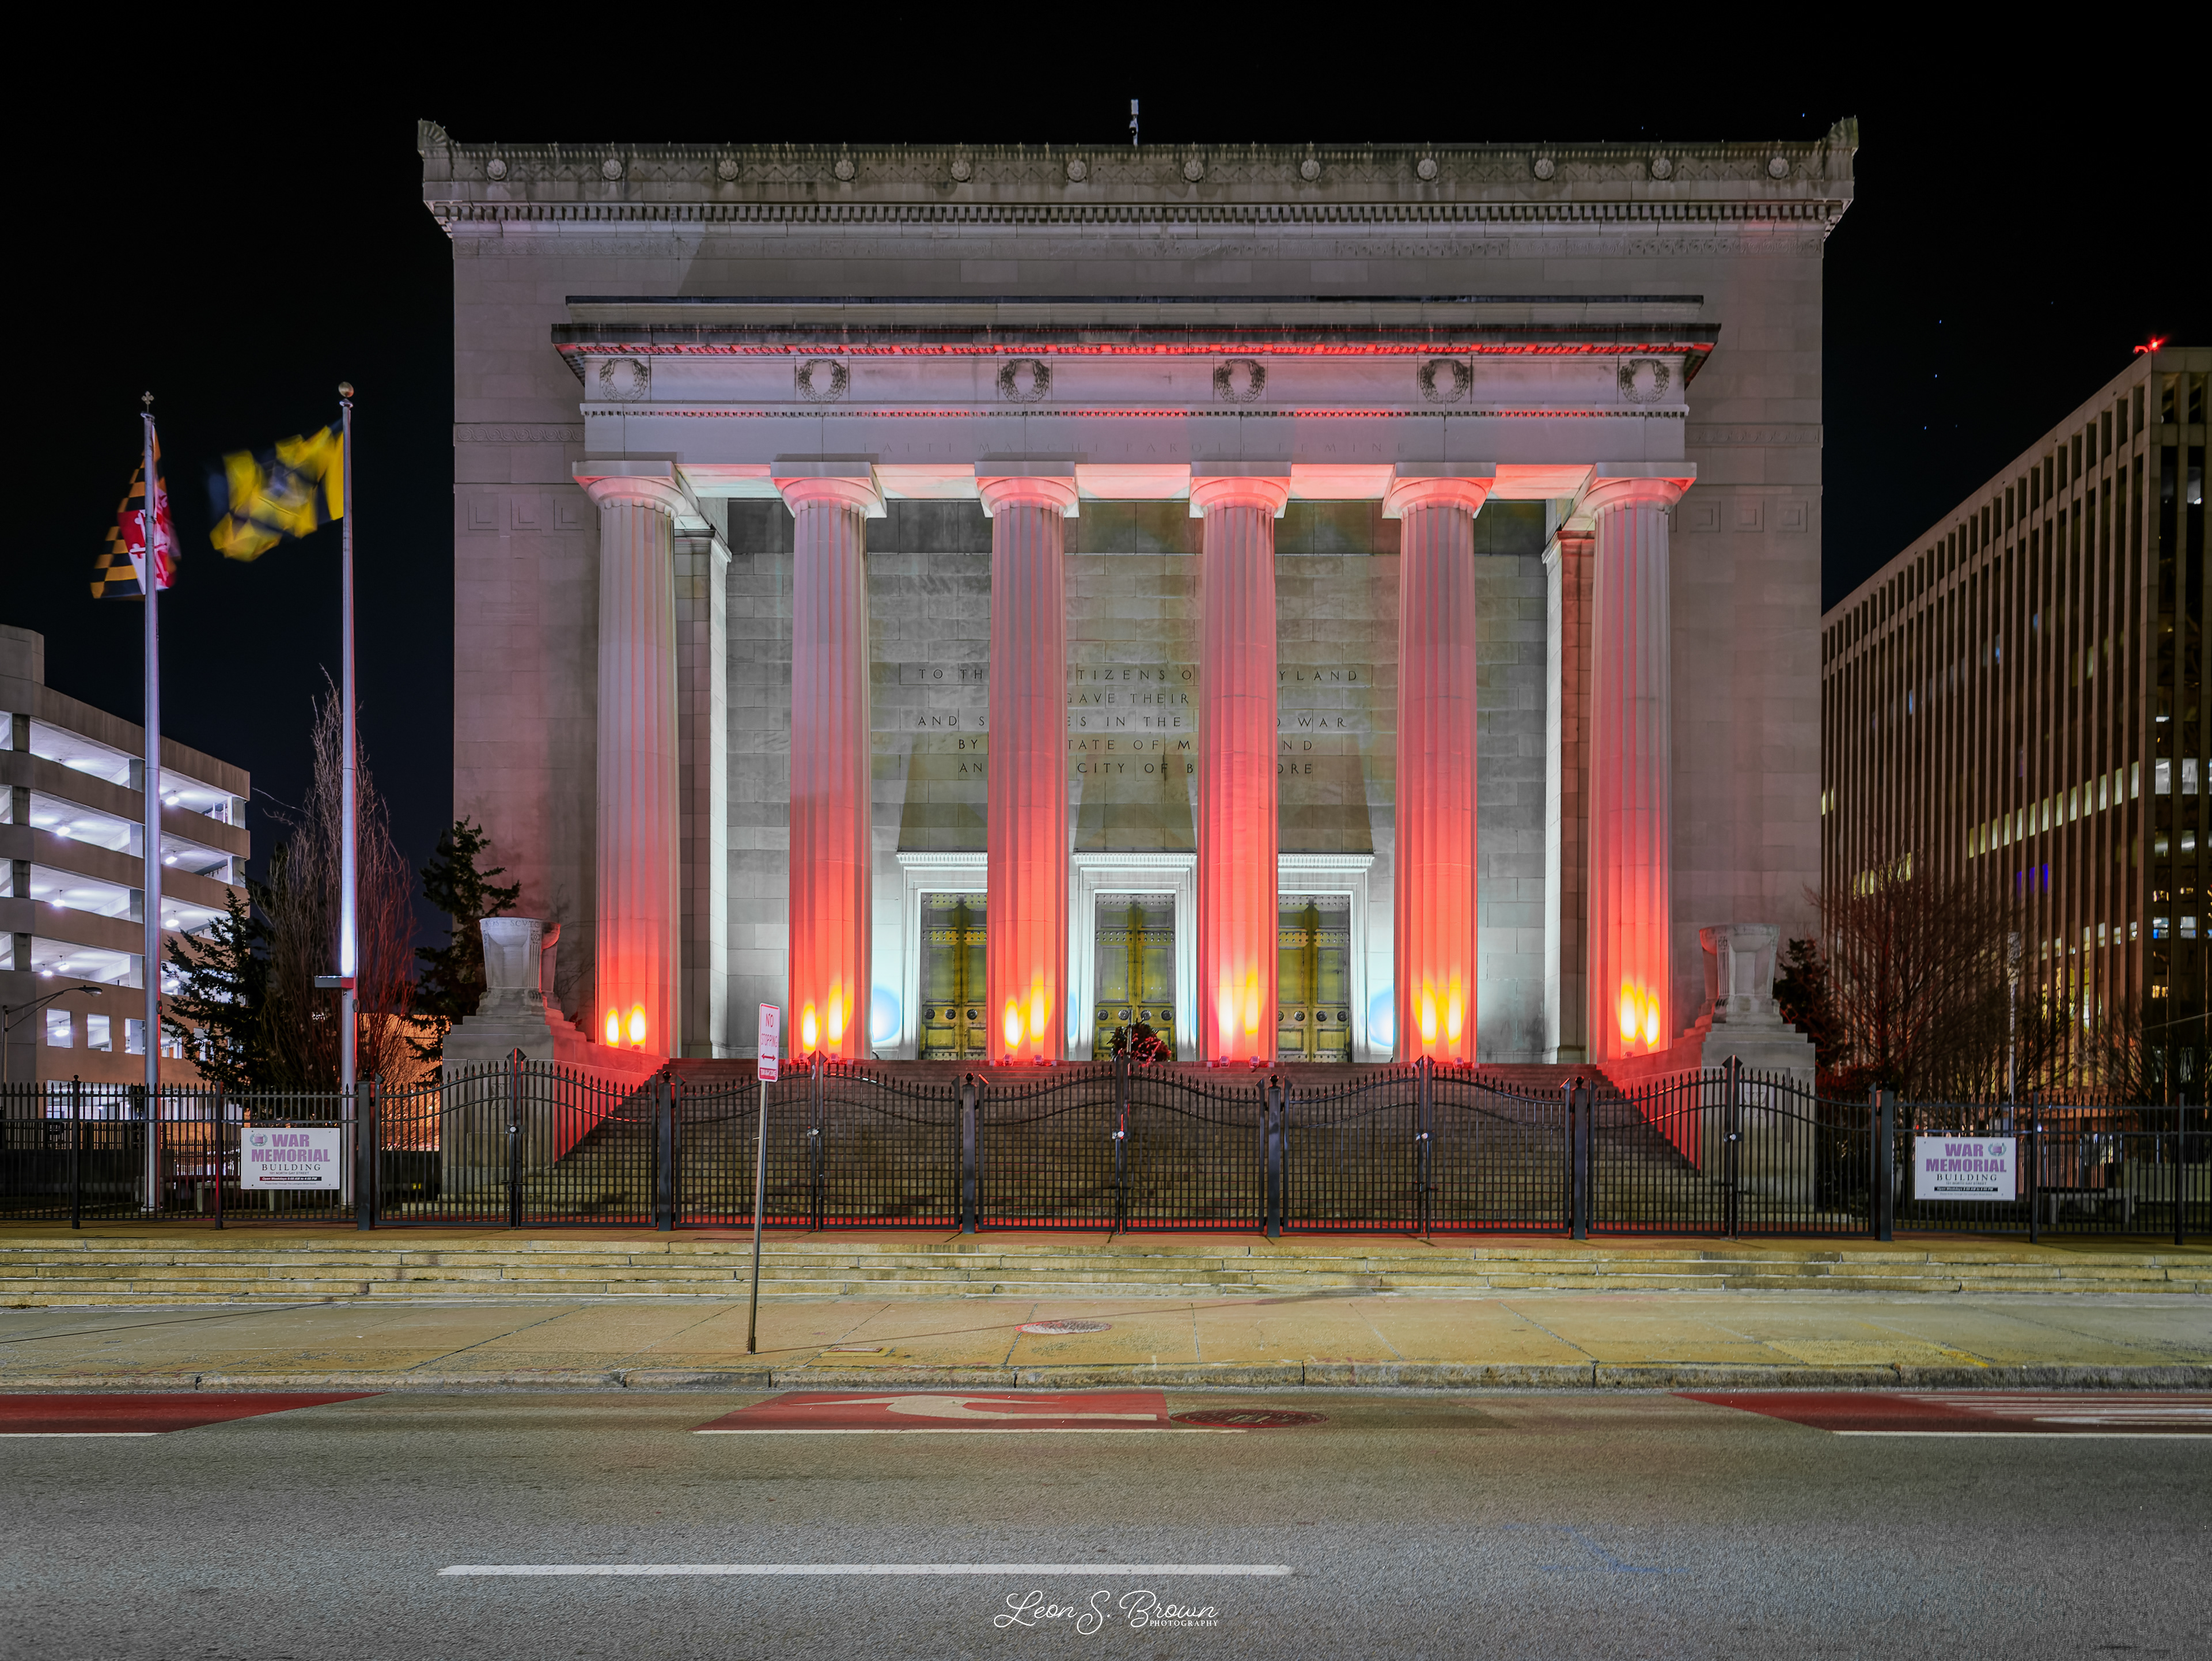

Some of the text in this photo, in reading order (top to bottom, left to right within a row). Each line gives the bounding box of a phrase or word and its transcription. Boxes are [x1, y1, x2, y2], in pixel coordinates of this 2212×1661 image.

[919, 669, 943, 679] TO
[960, 669, 983, 679] TH
[1066, 669, 1165, 680] ITIZENS
[1279, 671, 1357, 681] YLAND
[1130, 693, 1190, 704] THEIR
[918, 716, 1347, 728] AND IN THE WAR
[959, 739, 1159, 750] BY TATE OF
[959, 762, 1168, 774] AN CITY OF
[765, 1013, 774, 1028] NO
[761, 1033, 778, 1047] STOPPING
[271, 1134, 310, 1147] WAR
[251, 1149, 331, 1162] MEMORIAL
[1944, 1143, 1984, 1157] WAR
[1926, 1158, 2007, 1172] MEMORIAL
[1936, 1173, 1998, 1181] BUILDING
